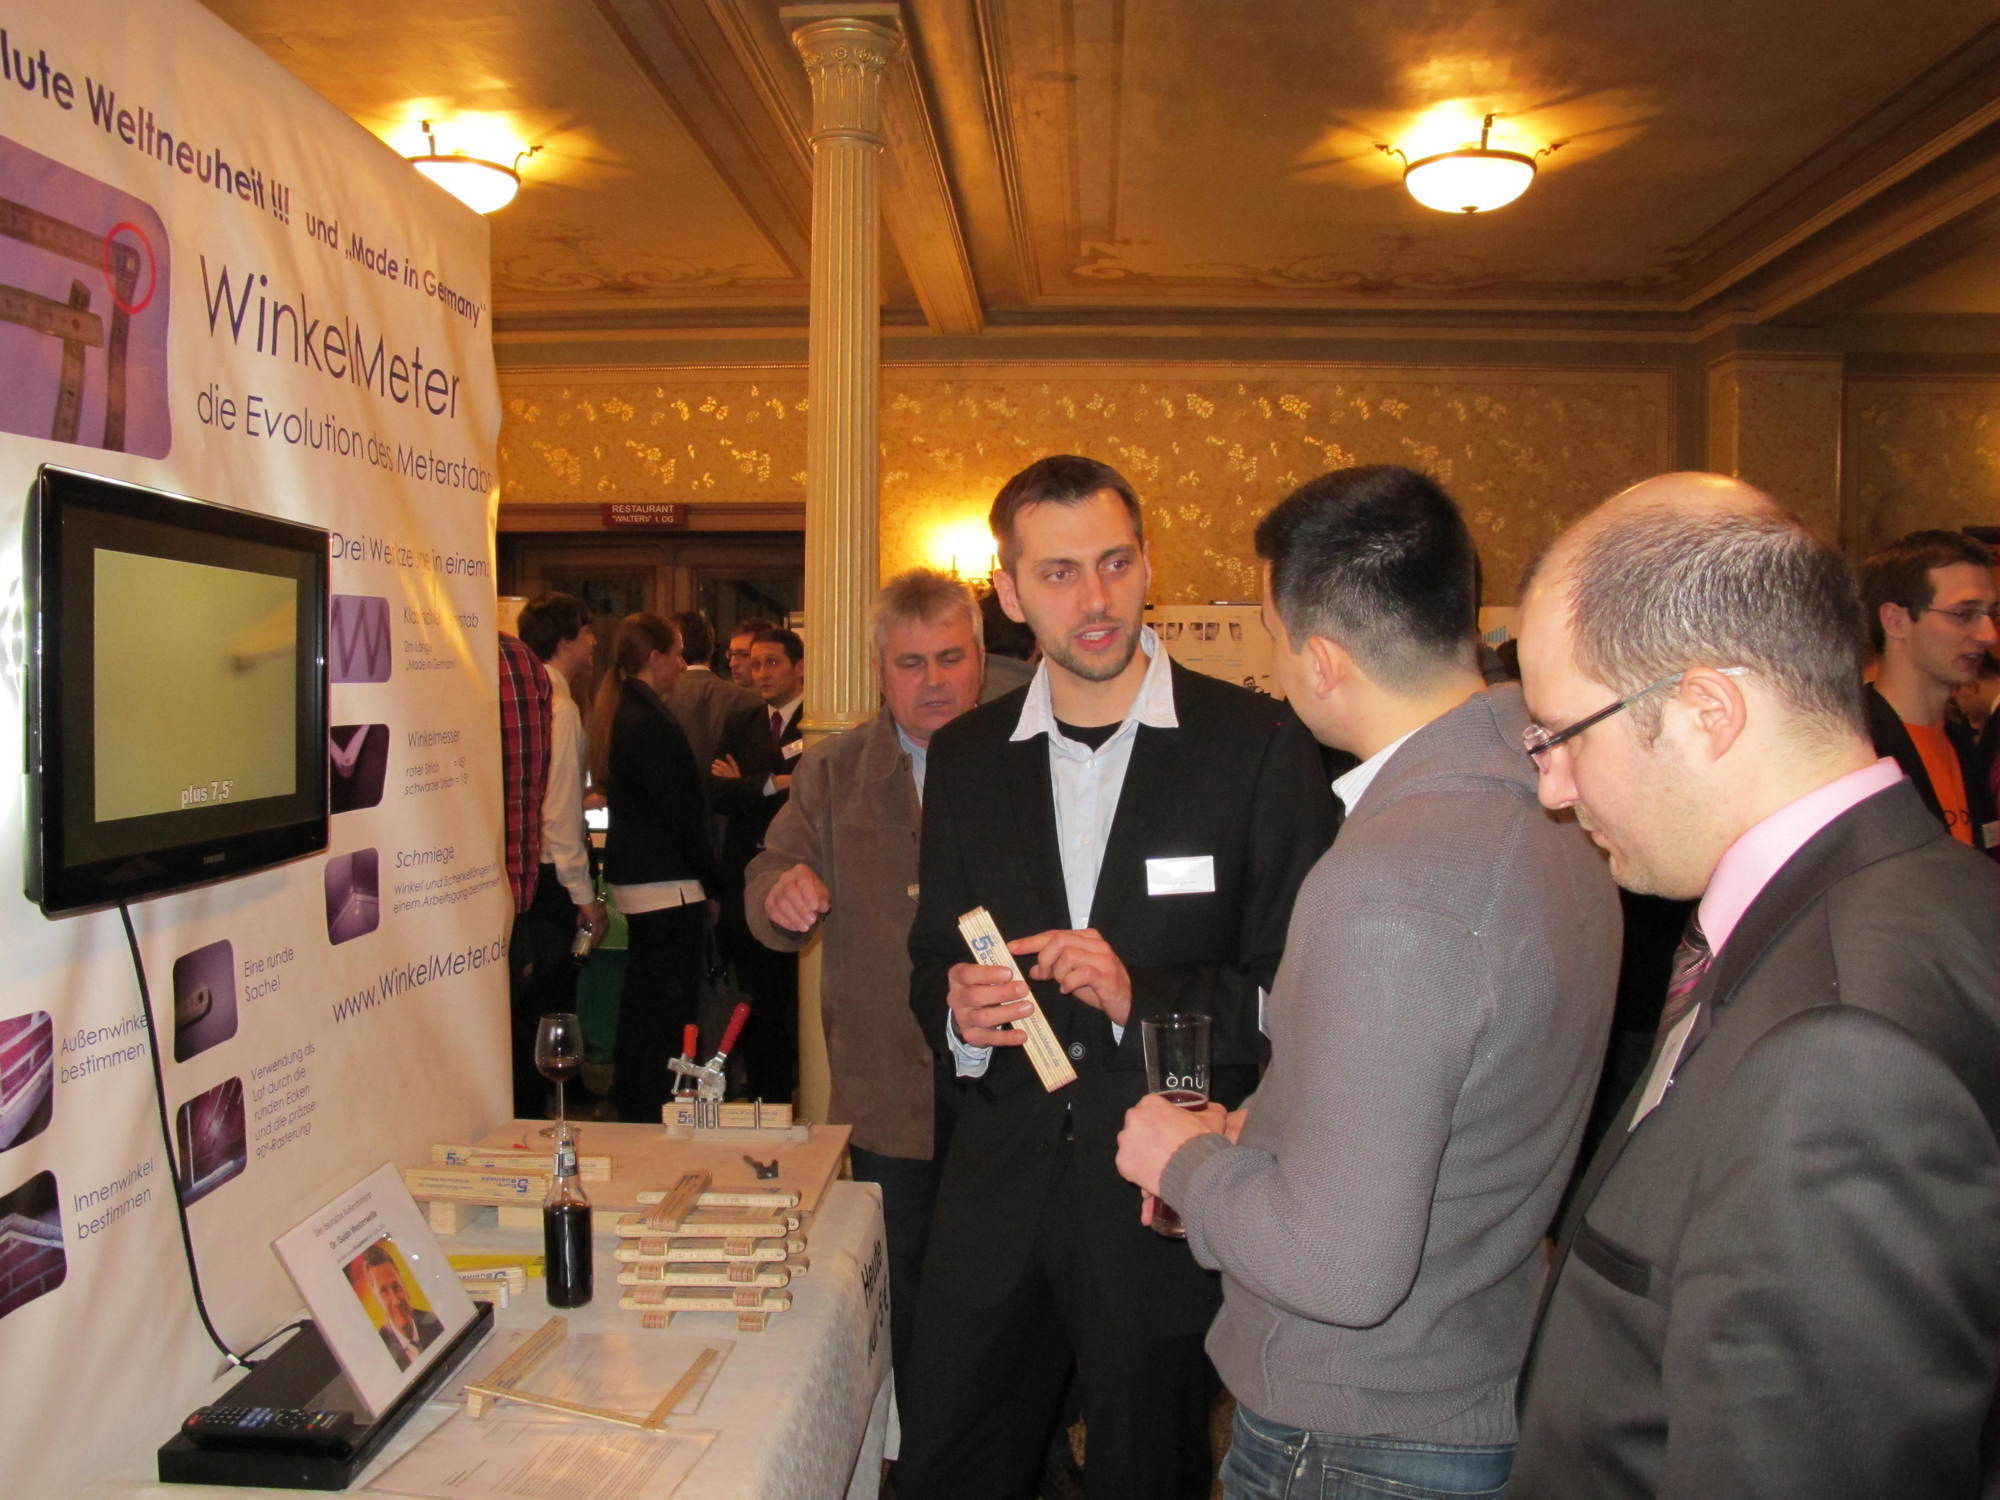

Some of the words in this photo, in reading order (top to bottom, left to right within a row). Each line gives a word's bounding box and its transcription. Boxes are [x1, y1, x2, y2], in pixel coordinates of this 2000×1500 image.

[85, 76, 265, 210] Weltneuheit
[271, 180, 289, 225] !!!
[306, 212, 338, 249] und
[403, 258, 418, 290] in
[199, 254, 460, 419] WinkelMeter
[197, 383, 237, 431] die
[246, 394, 364, 460] Evolution
[367, 433, 394, 472] des
[612, 504, 674, 513] RESTAURANT
[332, 532, 366, 561] Drei
[432, 549, 442, 572] in
[181, 783, 208, 809] plus
[395, 846, 455, 869] Schmiege
[244, 957, 265, 978] Eine
[266, 947, 295, 969] runde
[60, 1012, 150, 1057] Außenwinke
[60, 1042, 146, 1085] bestimmen
[678, 1110, 688, 1124] 5
[446, 1152, 458, 1166] 5
[73, 1156, 154, 1212] Innenwinkel
[77, 1187, 152, 1240] bestimmen
